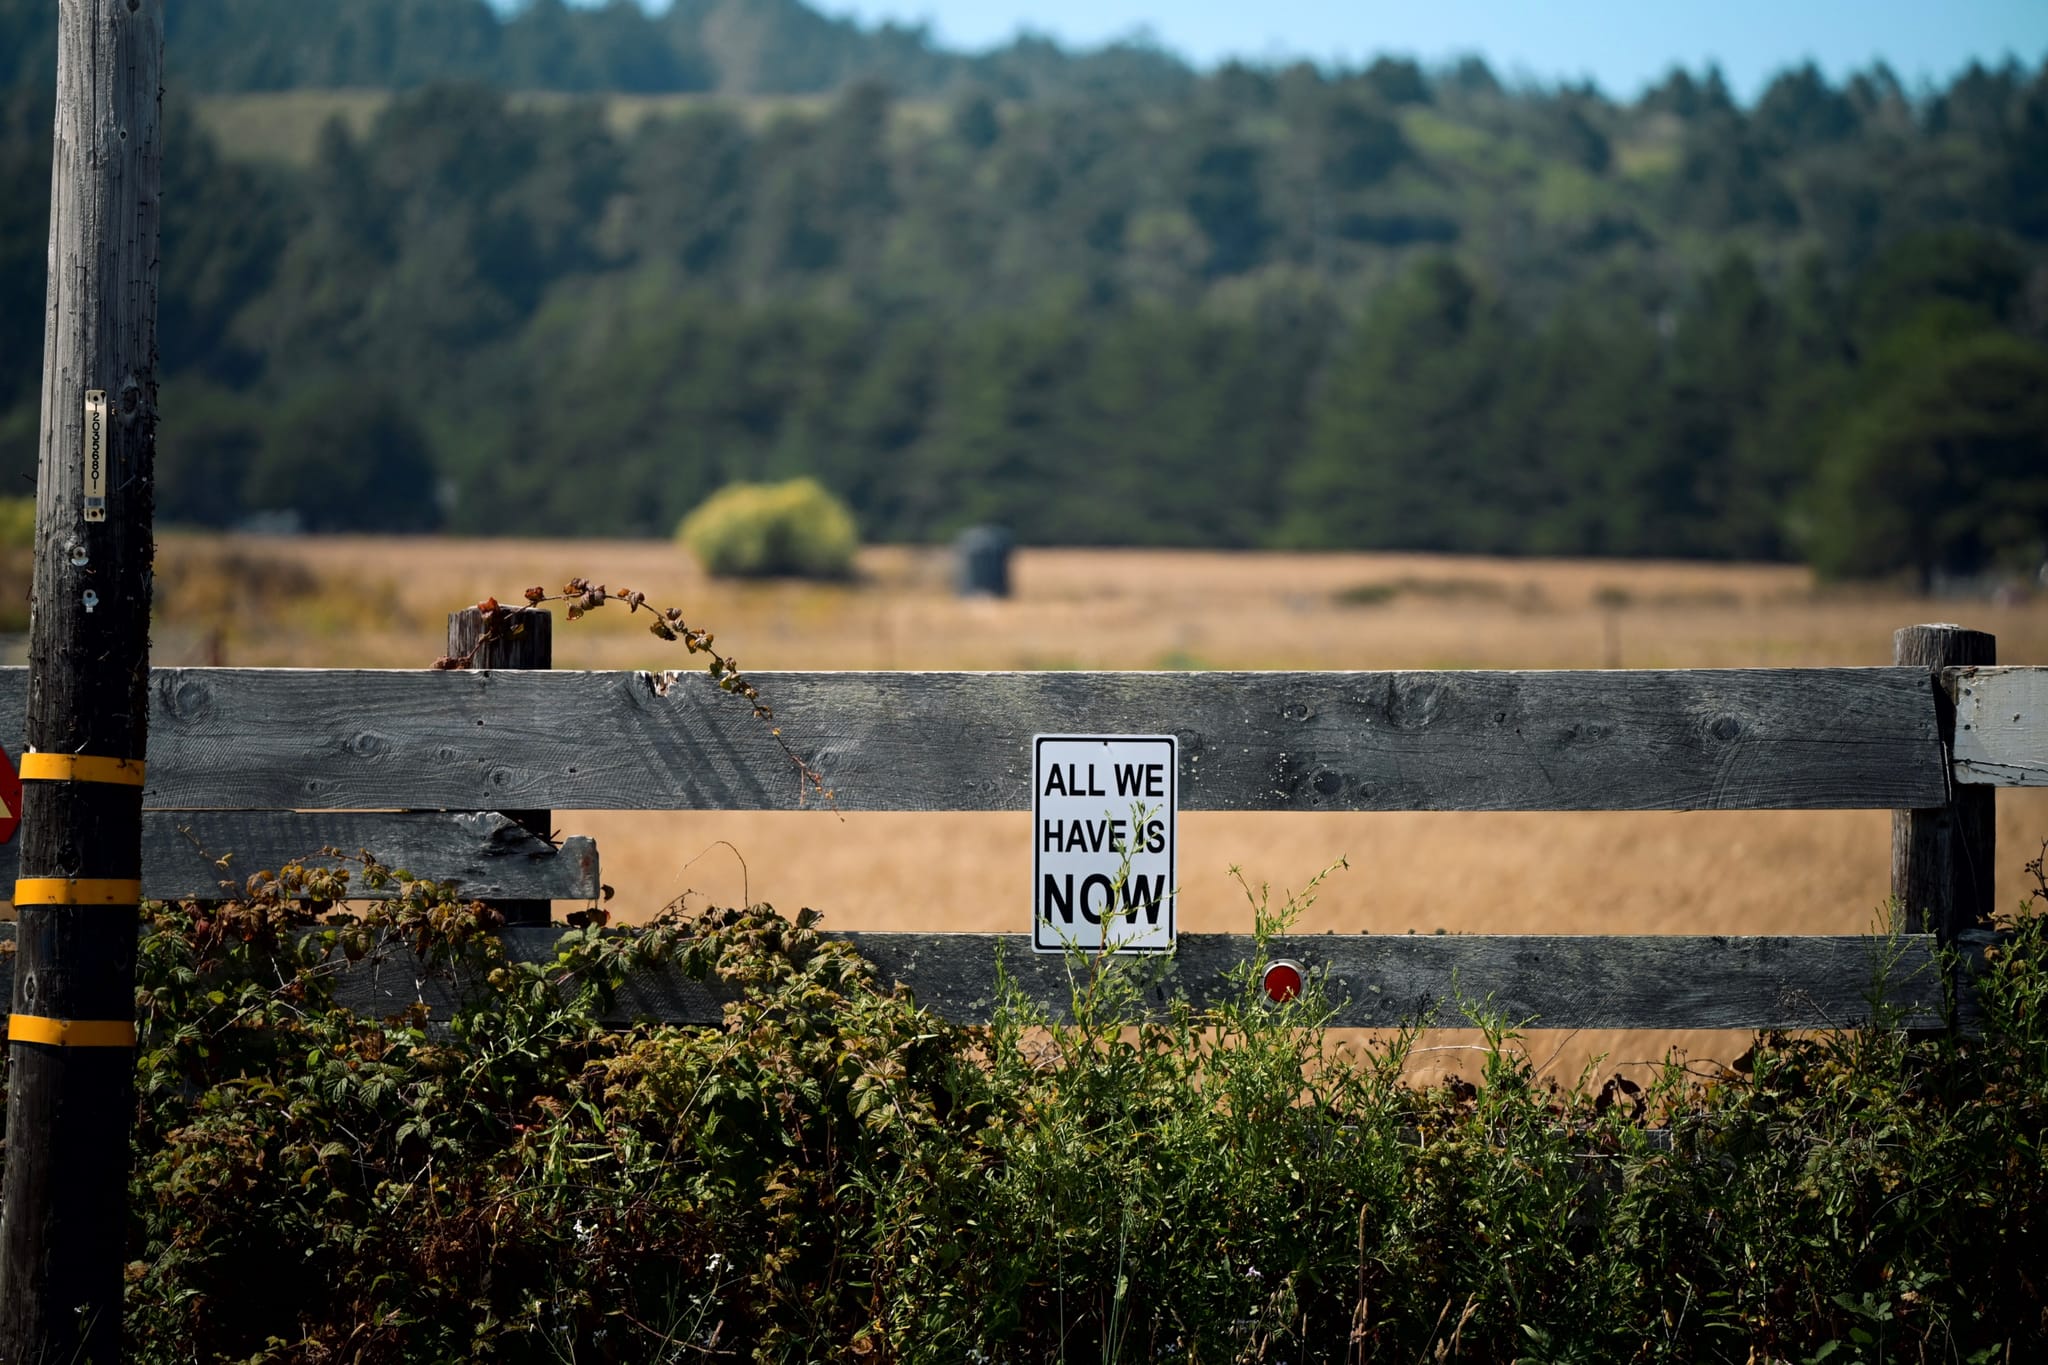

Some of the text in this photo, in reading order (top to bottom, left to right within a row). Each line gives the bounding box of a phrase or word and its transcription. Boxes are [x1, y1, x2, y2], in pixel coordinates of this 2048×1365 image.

[1044, 763, 1164, 797] ALL WE
[1044, 819, 1165, 853] HAVE IS
[1044, 873, 1166, 925] NOW
